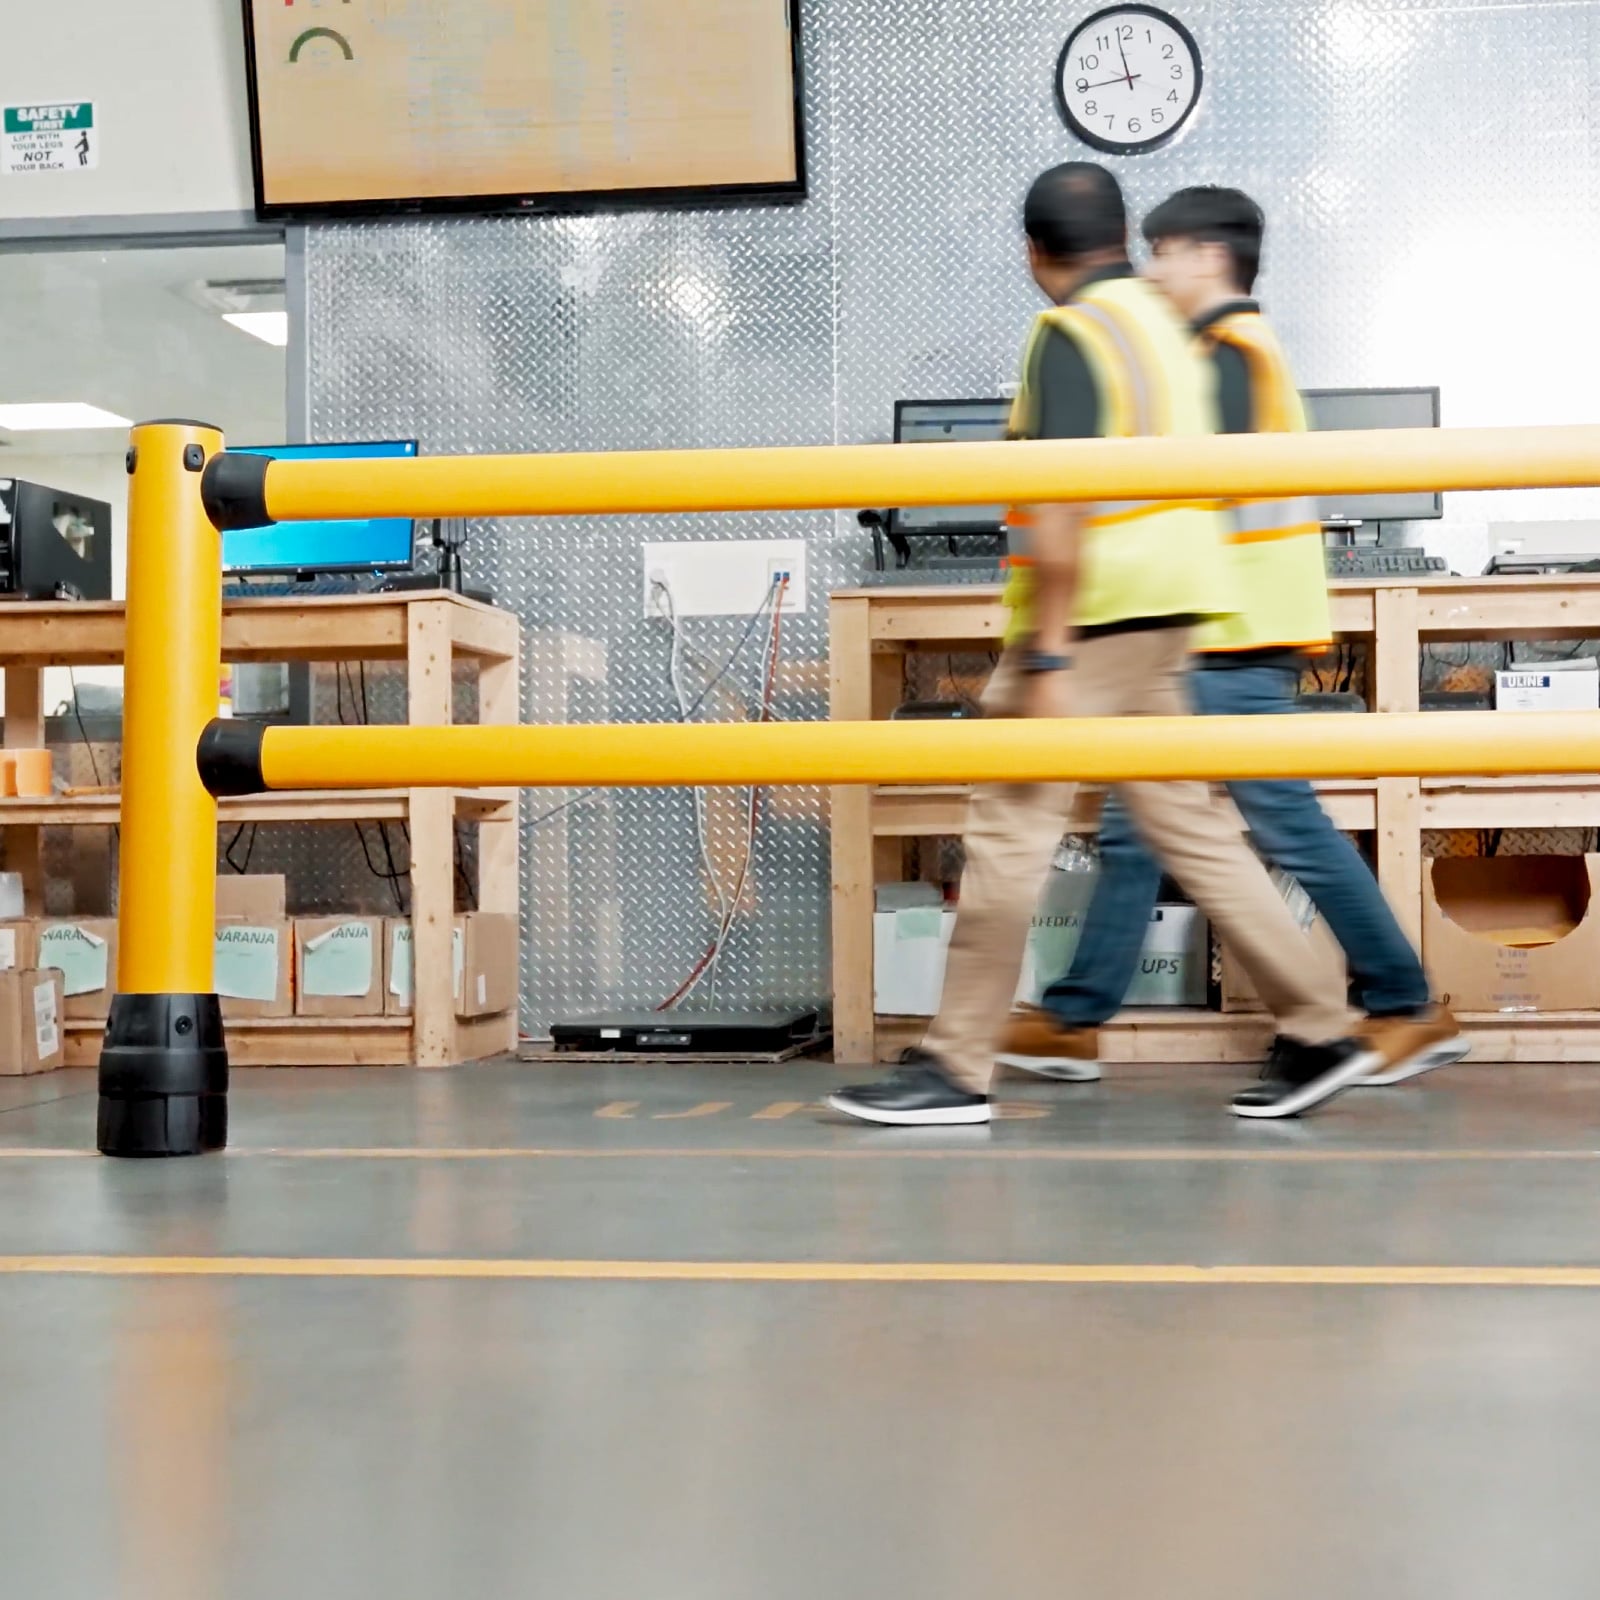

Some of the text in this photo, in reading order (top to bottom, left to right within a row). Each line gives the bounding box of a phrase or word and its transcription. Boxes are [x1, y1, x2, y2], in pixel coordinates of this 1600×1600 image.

[1115, 25, 1133, 41] 12
[1145, 29, 1152, 44] 1
[1096, 35, 1110, 51] 11
[1161, 44, 1174, 60] 2
[1078, 54, 1099, 71] 10
[1170, 64, 1183, 80] 3
[1075, 78, 1089, 94] 9
[1166, 88, 1179, 104] 4
[17, 104, 80, 122] SAFETY
[1084, 100, 1098, 116] 8
[1151, 107, 1165, 124] 5
[1104, 114, 1115, 130] 7
[1128, 117, 1142, 133] 6
[13, 132, 60, 142] LIFT WITH
[11, 140, 64, 151] YOUR LEGS
[23, 150, 53, 162] NOT
[10, 161, 65, 172] YOUR BACK
[1507, 675, 1544, 688] ULINE
[46, 928, 84, 941] NARA
[331, 927, 369, 939] ANJA
[1141, 958, 1180, 975] UPS
